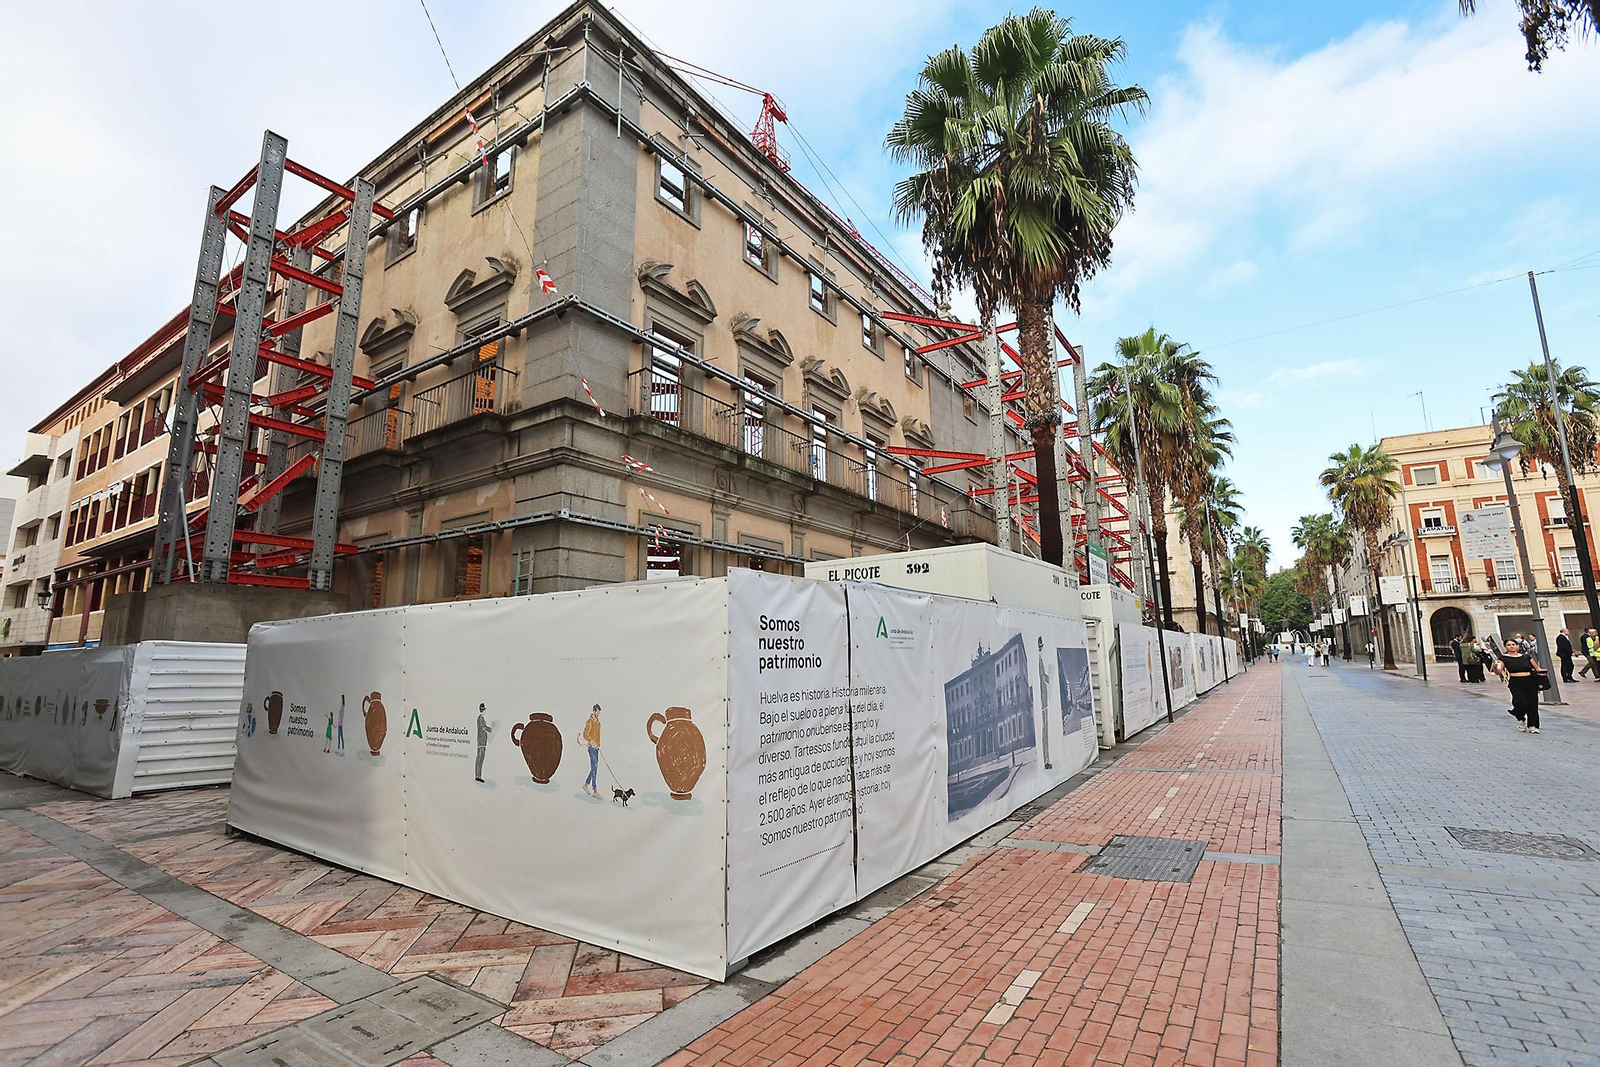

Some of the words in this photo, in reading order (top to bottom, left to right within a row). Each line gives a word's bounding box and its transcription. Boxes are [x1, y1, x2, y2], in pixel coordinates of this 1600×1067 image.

[828, 570, 840, 582] EL
[844, 566, 880, 580] PICOTE
[906, 563, 930, 574] 392
[1081, 591, 1100, 600] COTE
[760, 614, 800, 632] Somos
[758, 636, 805, 650] nuestro
[759, 654, 822, 674] patrimonio
[760, 691, 788, 704] Huelva
[790, 692, 800, 702] es
[832, 686, 858, 698] Historia
[290, 702, 306, 714] Somos
[760, 711, 780, 727] Bajo
[780, 710, 788, 722] el
[790, 708, 812, 721] suelo
[812, 708, 818, 718] o
[818, 708, 824, 718] a
[824, 704, 844, 719] plena
[288, 716, 308, 726] nuestro
[287, 726, 314, 738] patrimonio
[446, 726, 468, 736] Andalucía
[760, 727, 805, 748] patrimonio
[806, 723, 842, 738] onubense
[854, 718, 874, 732] amplio
[874, 719, 880, 730] y
[758, 750, 792, 765] diverso.
[794, 742, 832, 758] Tartessos
[874, 730, 895, 743] ciudad
[758, 770, 777, 785] más
[778, 765, 810, 780] antigua
[811, 762, 822, 774] de
[822, 755, 858, 770] occidene
[858, 754, 864, 766] y
[864, 752, 874, 762] hoy
[875, 747, 896, 760] somos
[758, 792, 766, 806] el
[768, 786, 796, 802] reflejo
[798, 783, 808, 796] de
[810, 780, 816, 792] lo
[817, 778, 832, 792] que
[870, 764, 882, 776] más
[882, 762, 891, 773] de
[760, 807, 784, 826] 2.500
[786, 804, 808, 818] años.
[808, 798, 826, 812] Ayer
[880, 780, 892, 791] hoy
[792, 817, 824, 836] nuestro
